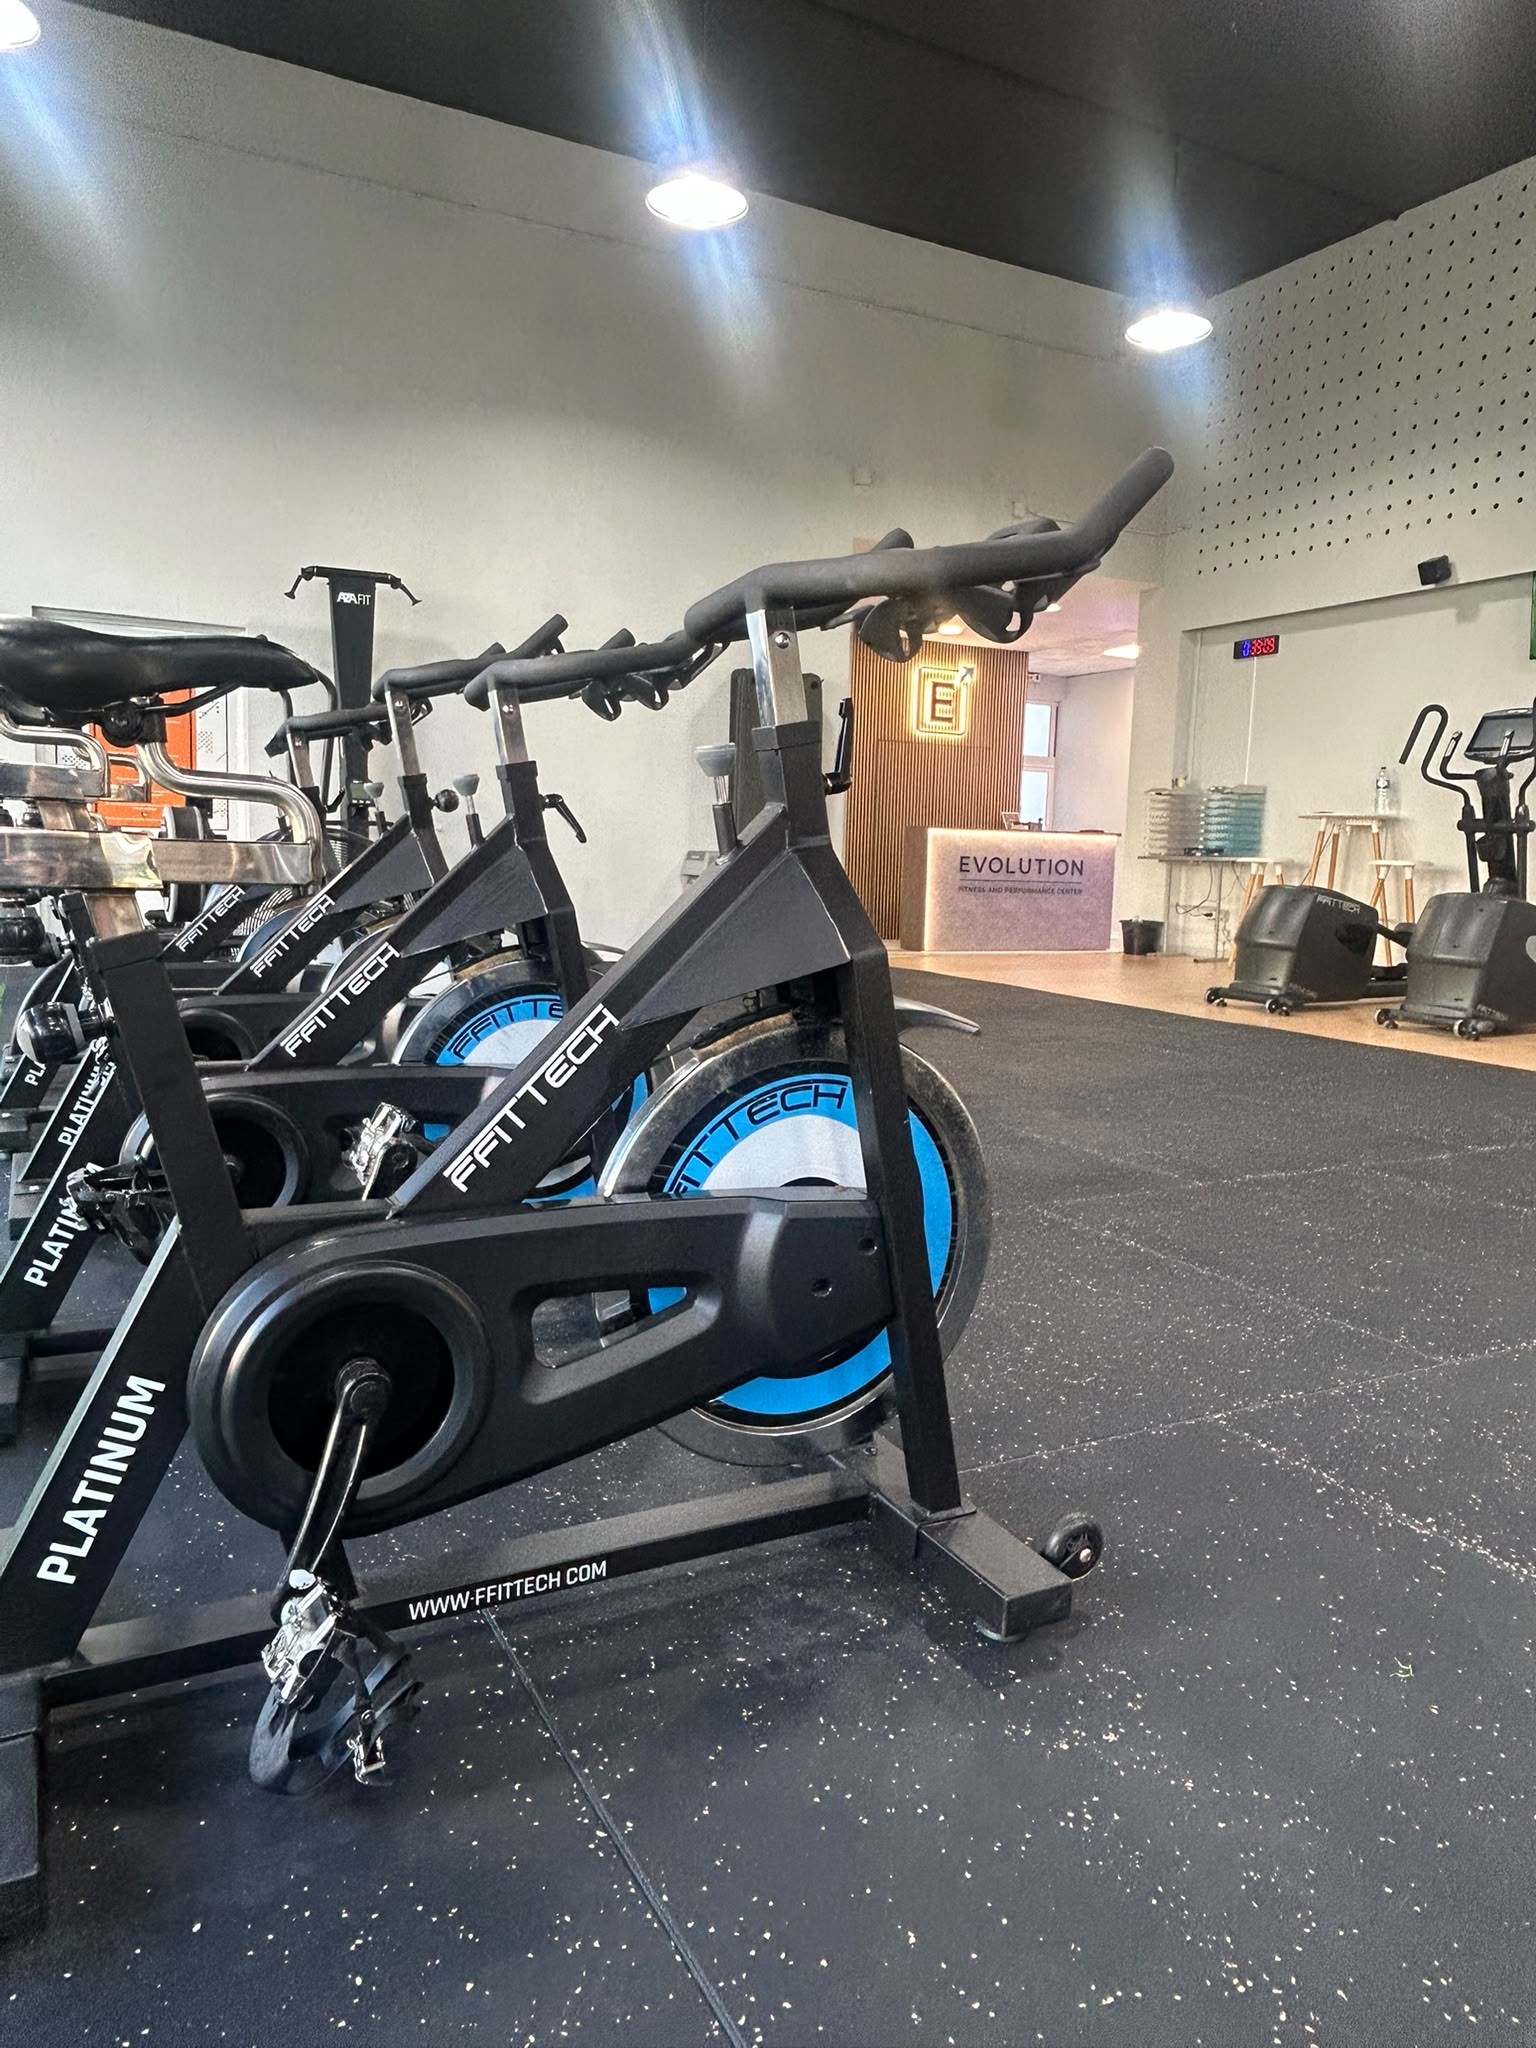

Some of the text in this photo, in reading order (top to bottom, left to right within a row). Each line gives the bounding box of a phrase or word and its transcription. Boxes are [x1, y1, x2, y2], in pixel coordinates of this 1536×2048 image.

[958, 886, 1083, 896] FITNESS AND PERFORMANCE CENTER
[959, 855, 1084, 876] EVOLUTION
[250, 894, 336, 978] FFITTECH
[280, 941, 400, 1058] FFITTECH
[447, 998, 564, 1060] FFITTE
[442, 1002, 620, 1193] FFITTECH
[36, 1375, 166, 1584] PLATINUM
